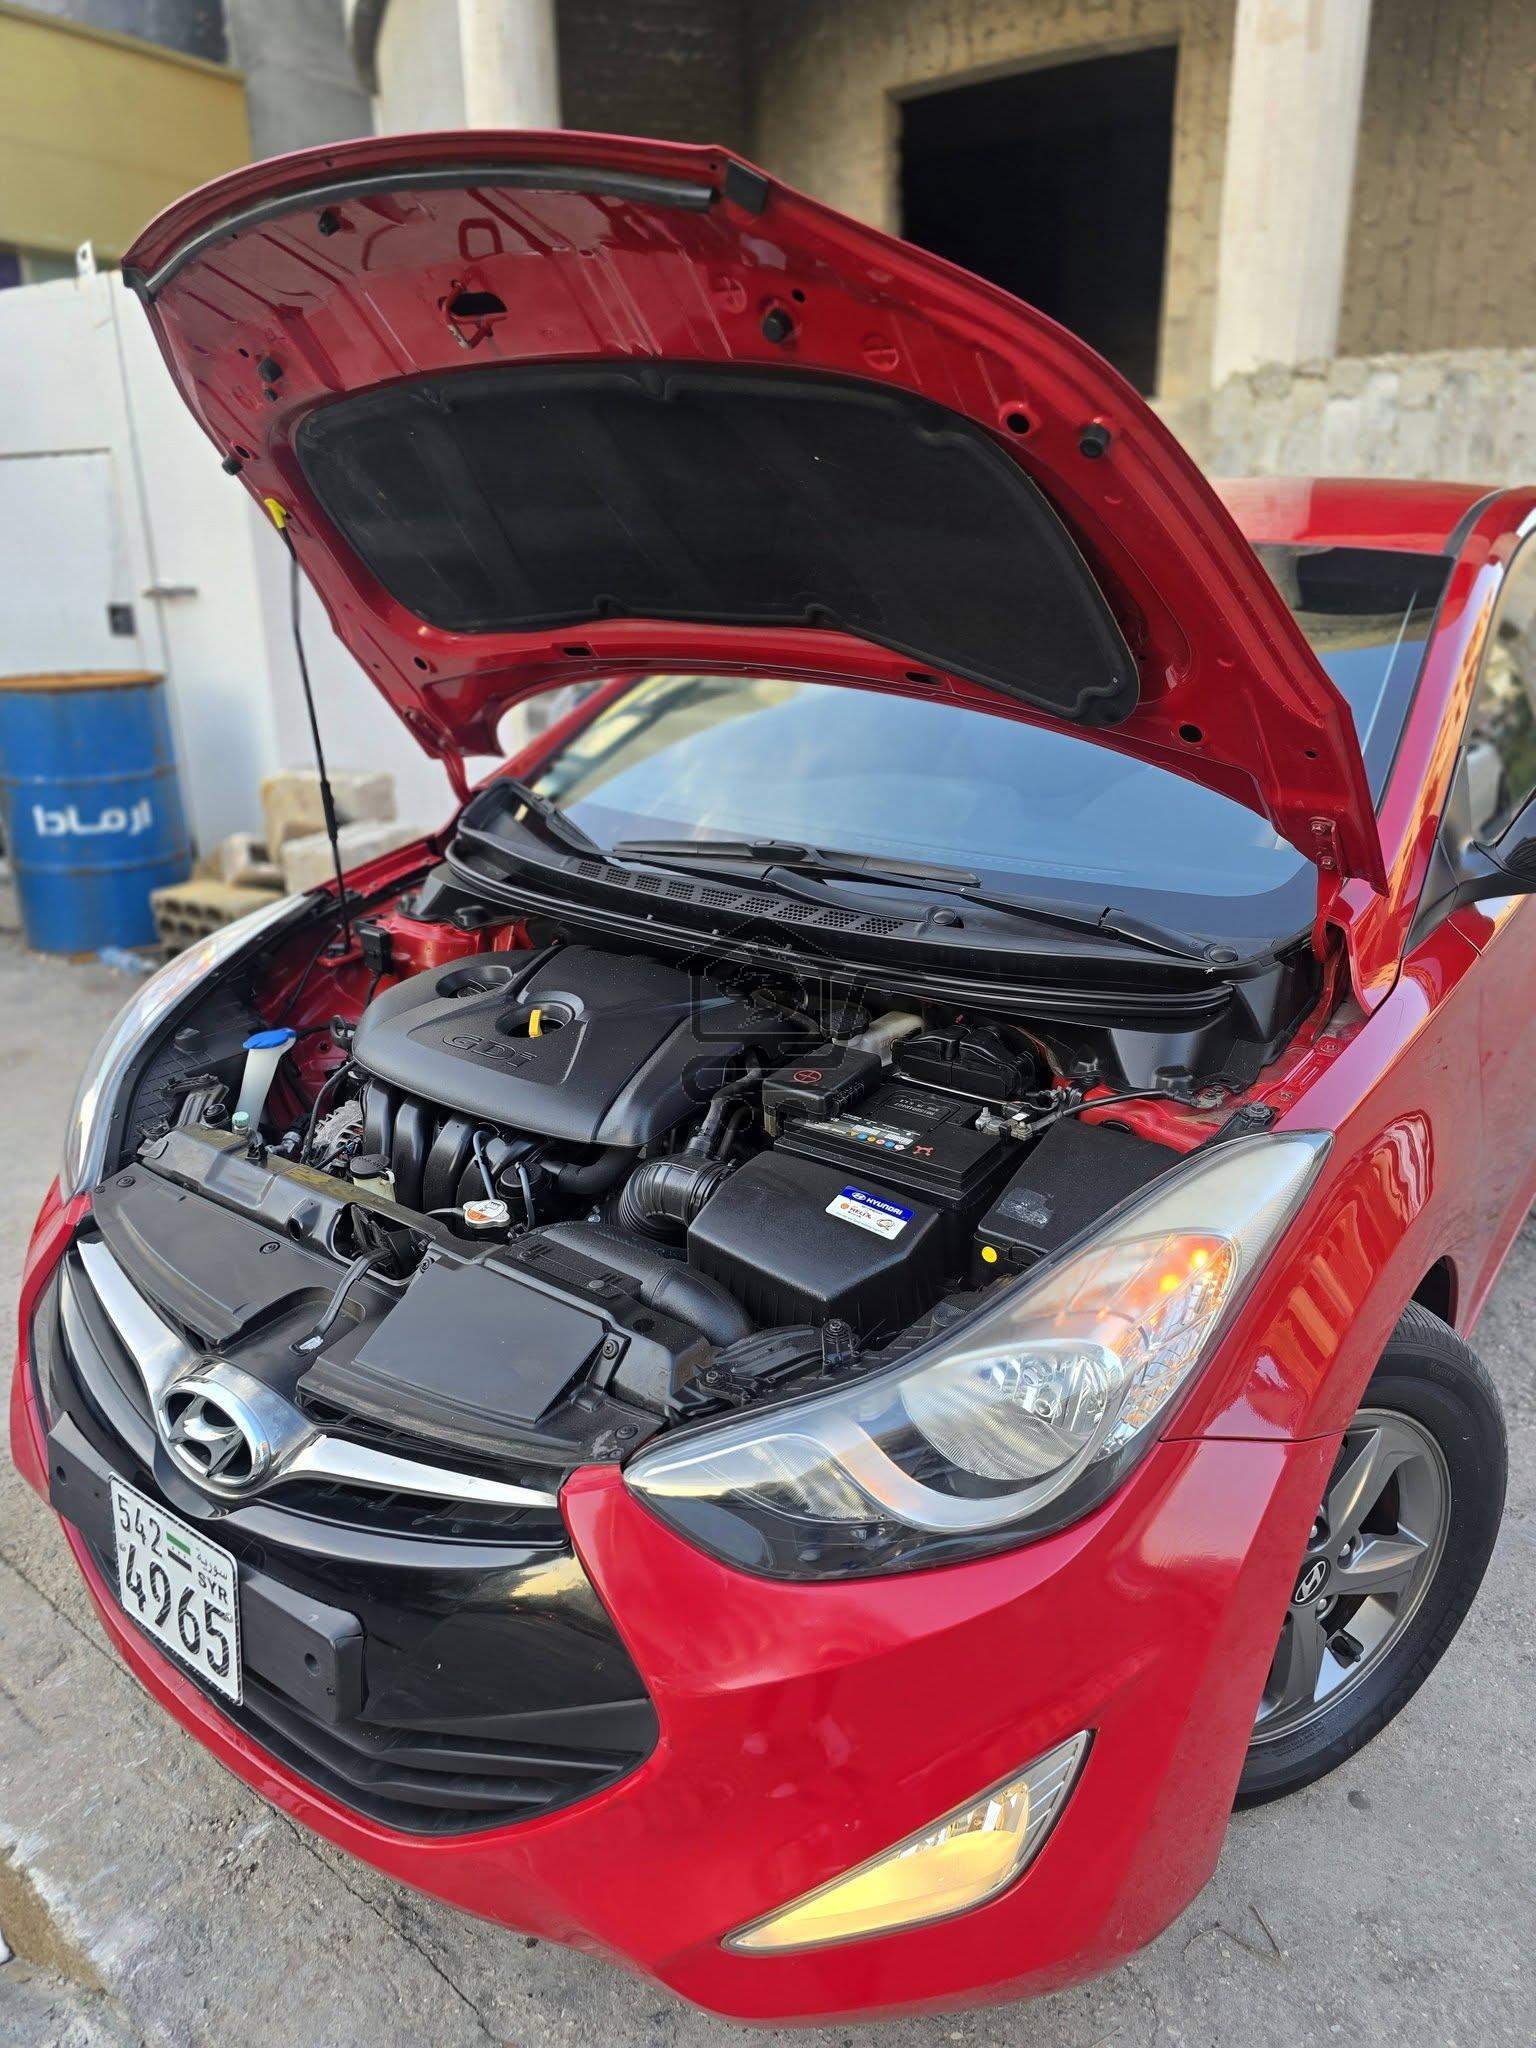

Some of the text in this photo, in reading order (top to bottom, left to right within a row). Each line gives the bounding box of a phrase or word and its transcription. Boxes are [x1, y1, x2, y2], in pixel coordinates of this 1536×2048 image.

[32, 798, 152, 837] ارمادا
[866, 1197, 903, 1216] HYUNDAI
[117, 1493, 163, 1558] 542
[198, 1571, 229, 1604] SYR
[126, 1543, 232, 1678] 4965
